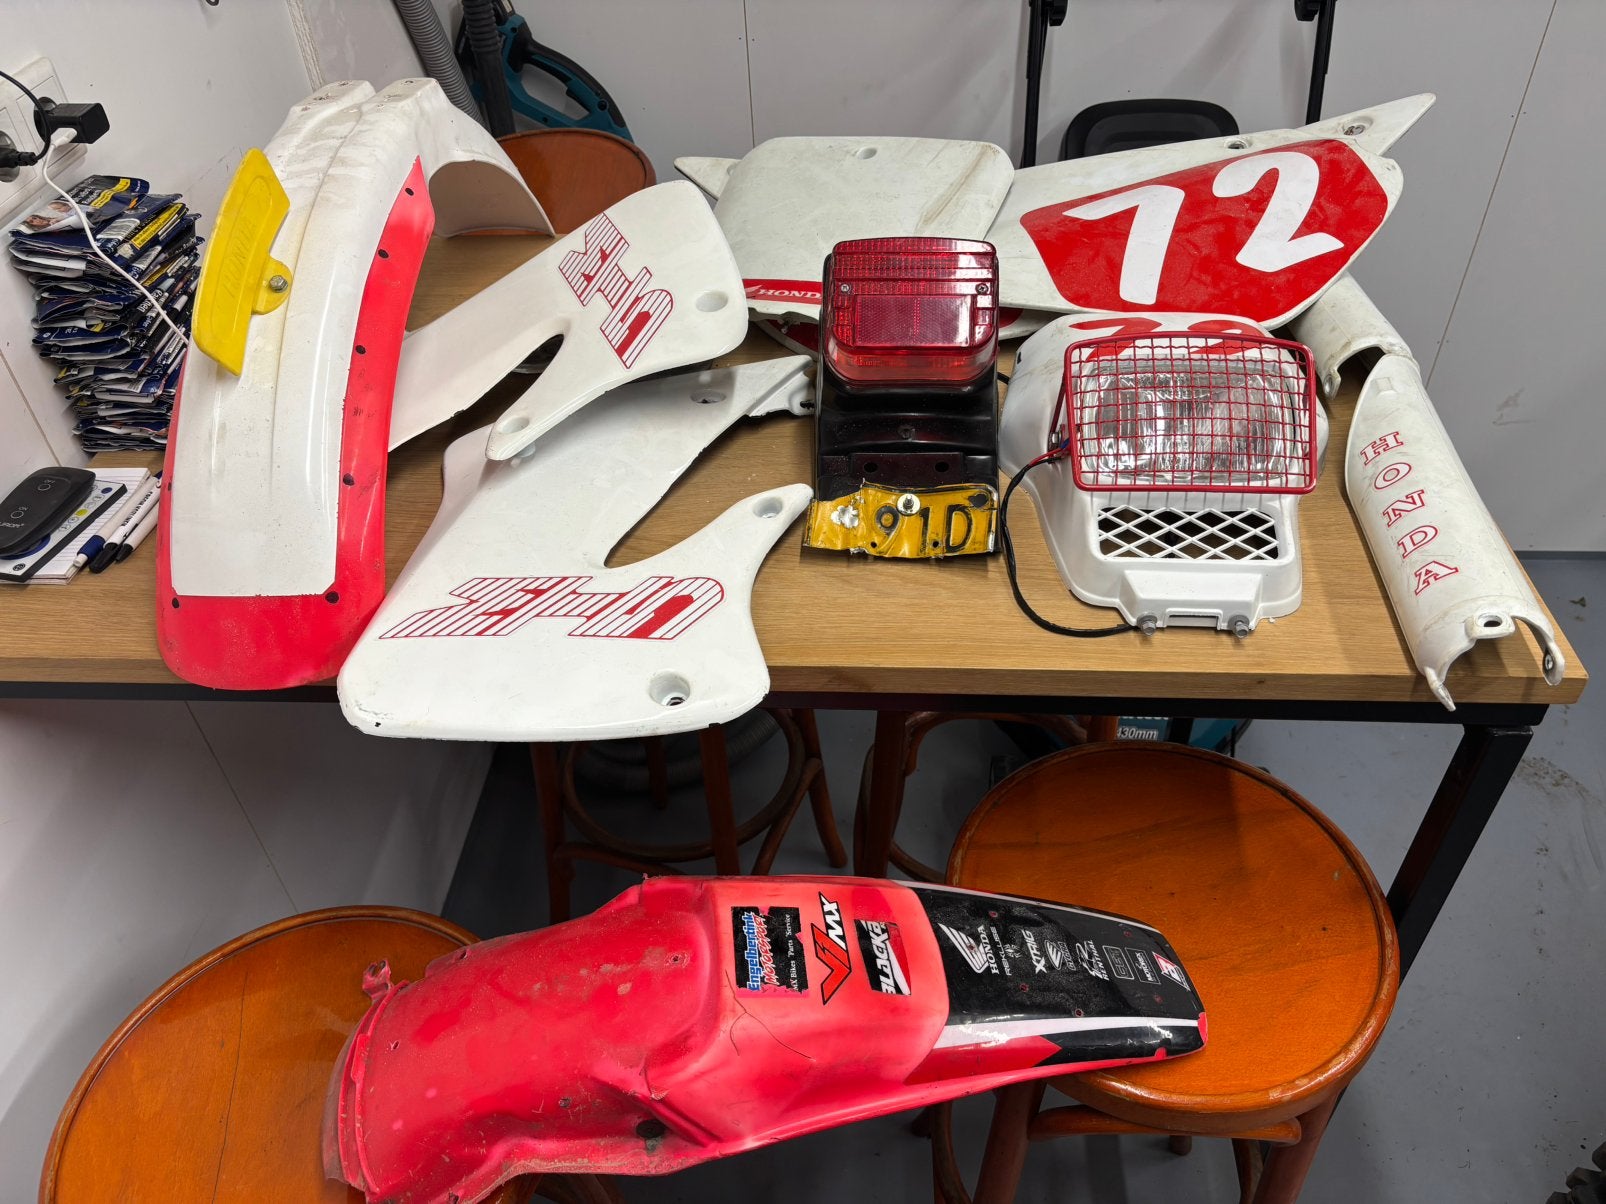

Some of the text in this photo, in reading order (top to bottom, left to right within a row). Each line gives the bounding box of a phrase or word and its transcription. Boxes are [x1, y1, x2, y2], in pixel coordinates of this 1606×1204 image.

[1062, 151, 1345, 305] 72
[758, 289, 823, 299] HOND
[1360, 431, 1459, 596] HONDA
[742, 912, 763, 991] Engelbertink
[751, 913, 780, 986] MOTORSPORT
[789, 961, 797, 978] Bikes
[977, 925, 1000, 974] HONDA
[1020, 929, 1048, 975] XTRIG
[1087, 940, 1110, 981] RENTHAL
